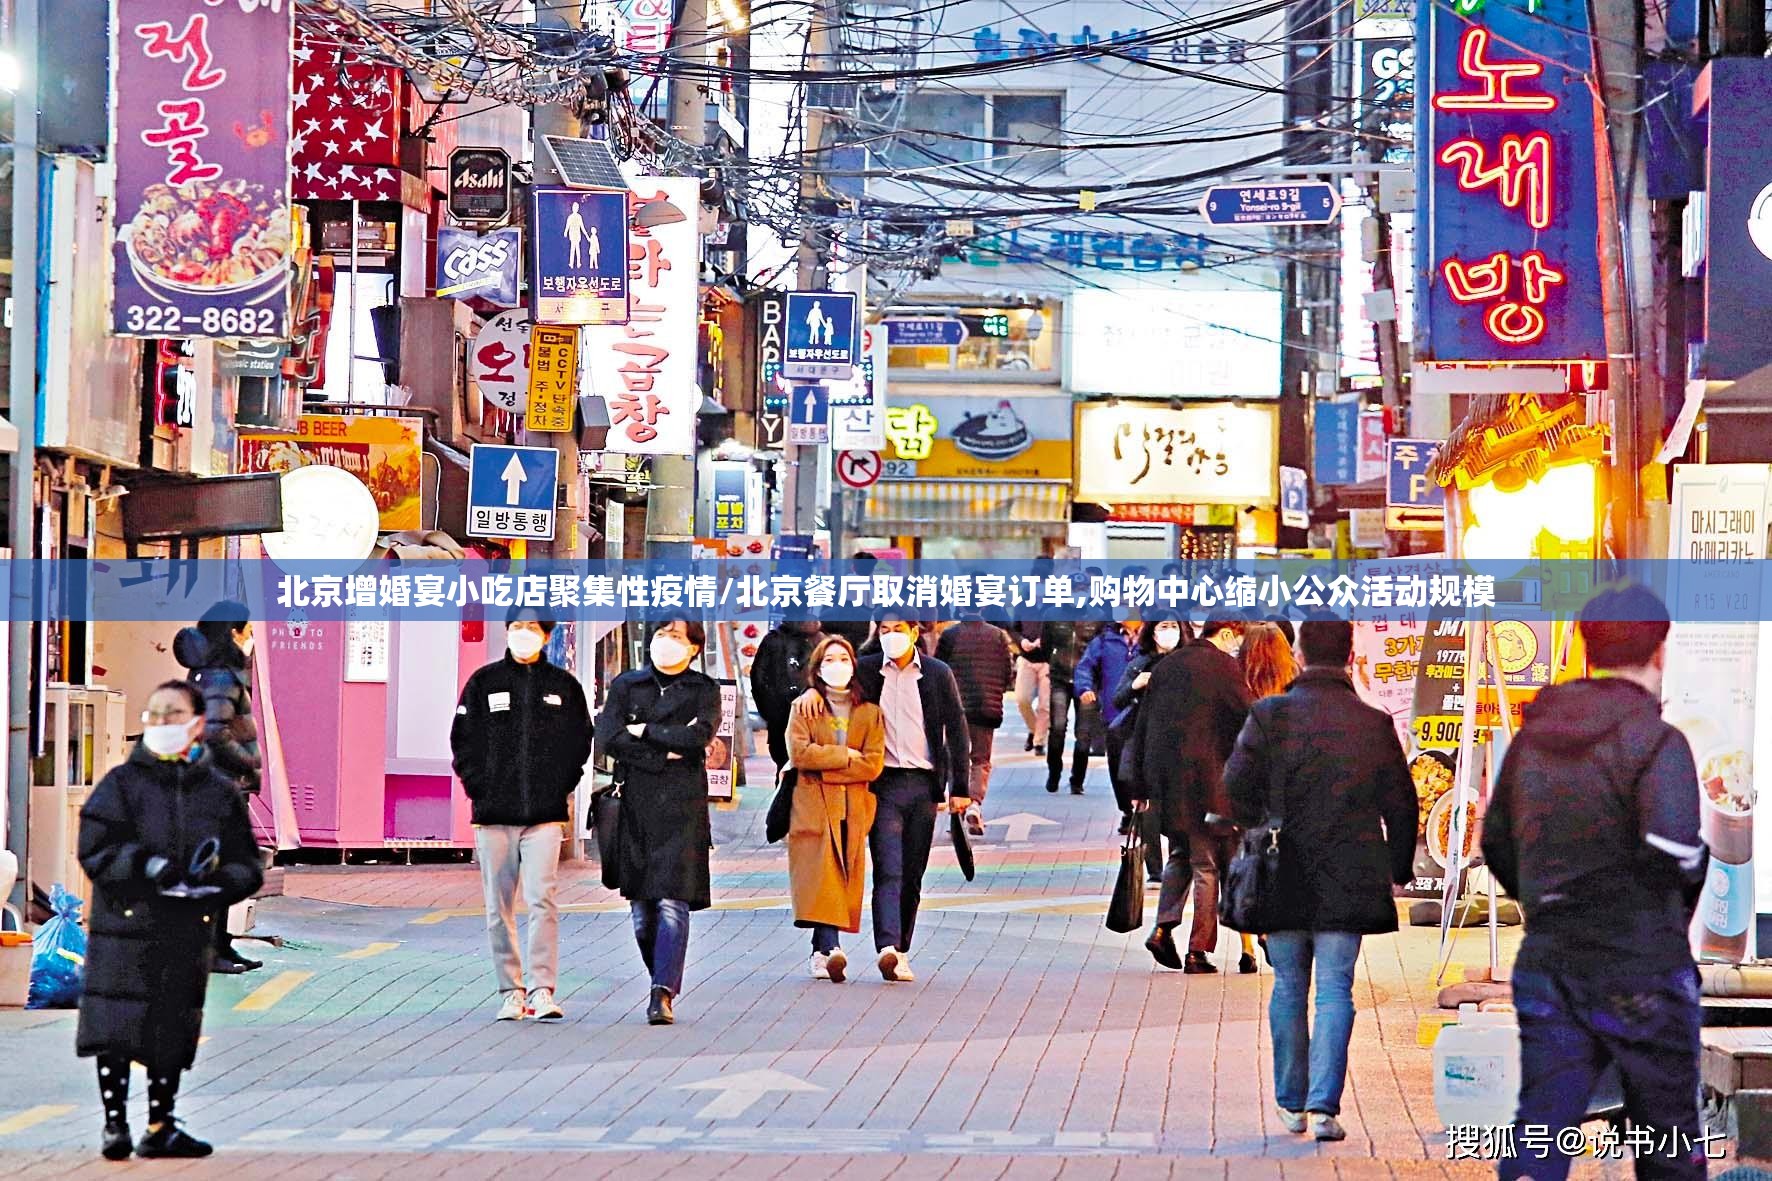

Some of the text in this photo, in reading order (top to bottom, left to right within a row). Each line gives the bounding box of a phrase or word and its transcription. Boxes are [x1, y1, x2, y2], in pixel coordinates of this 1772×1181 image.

[135, 13, 227, 187] 전골
[453, 167, 504, 189] Asahi
[1433, 25, 1563, 345] 노래방
[1210, 202, 1217, 211] 9
[1239, 188, 1300, 202] 연세로9길
[1322, 198, 1330, 208] 5
[1240, 203, 1302, 212] Yonsei-ro 9-gil
[543, 276, 622, 292] 보행자우선도로
[127, 305, 274, 334] 322-8682
[555, 348, 568, 389] CCTV
[313, 421, 347, 436] BEER
[1410, 474, 1427, 502] P
[476, 509, 548, 533] 일방통행
[1691, 510, 1755, 535] 마시그래이
[1690, 541, 1755, 566] 아메리카노
[271, 641, 324, 651] FRIENDS
